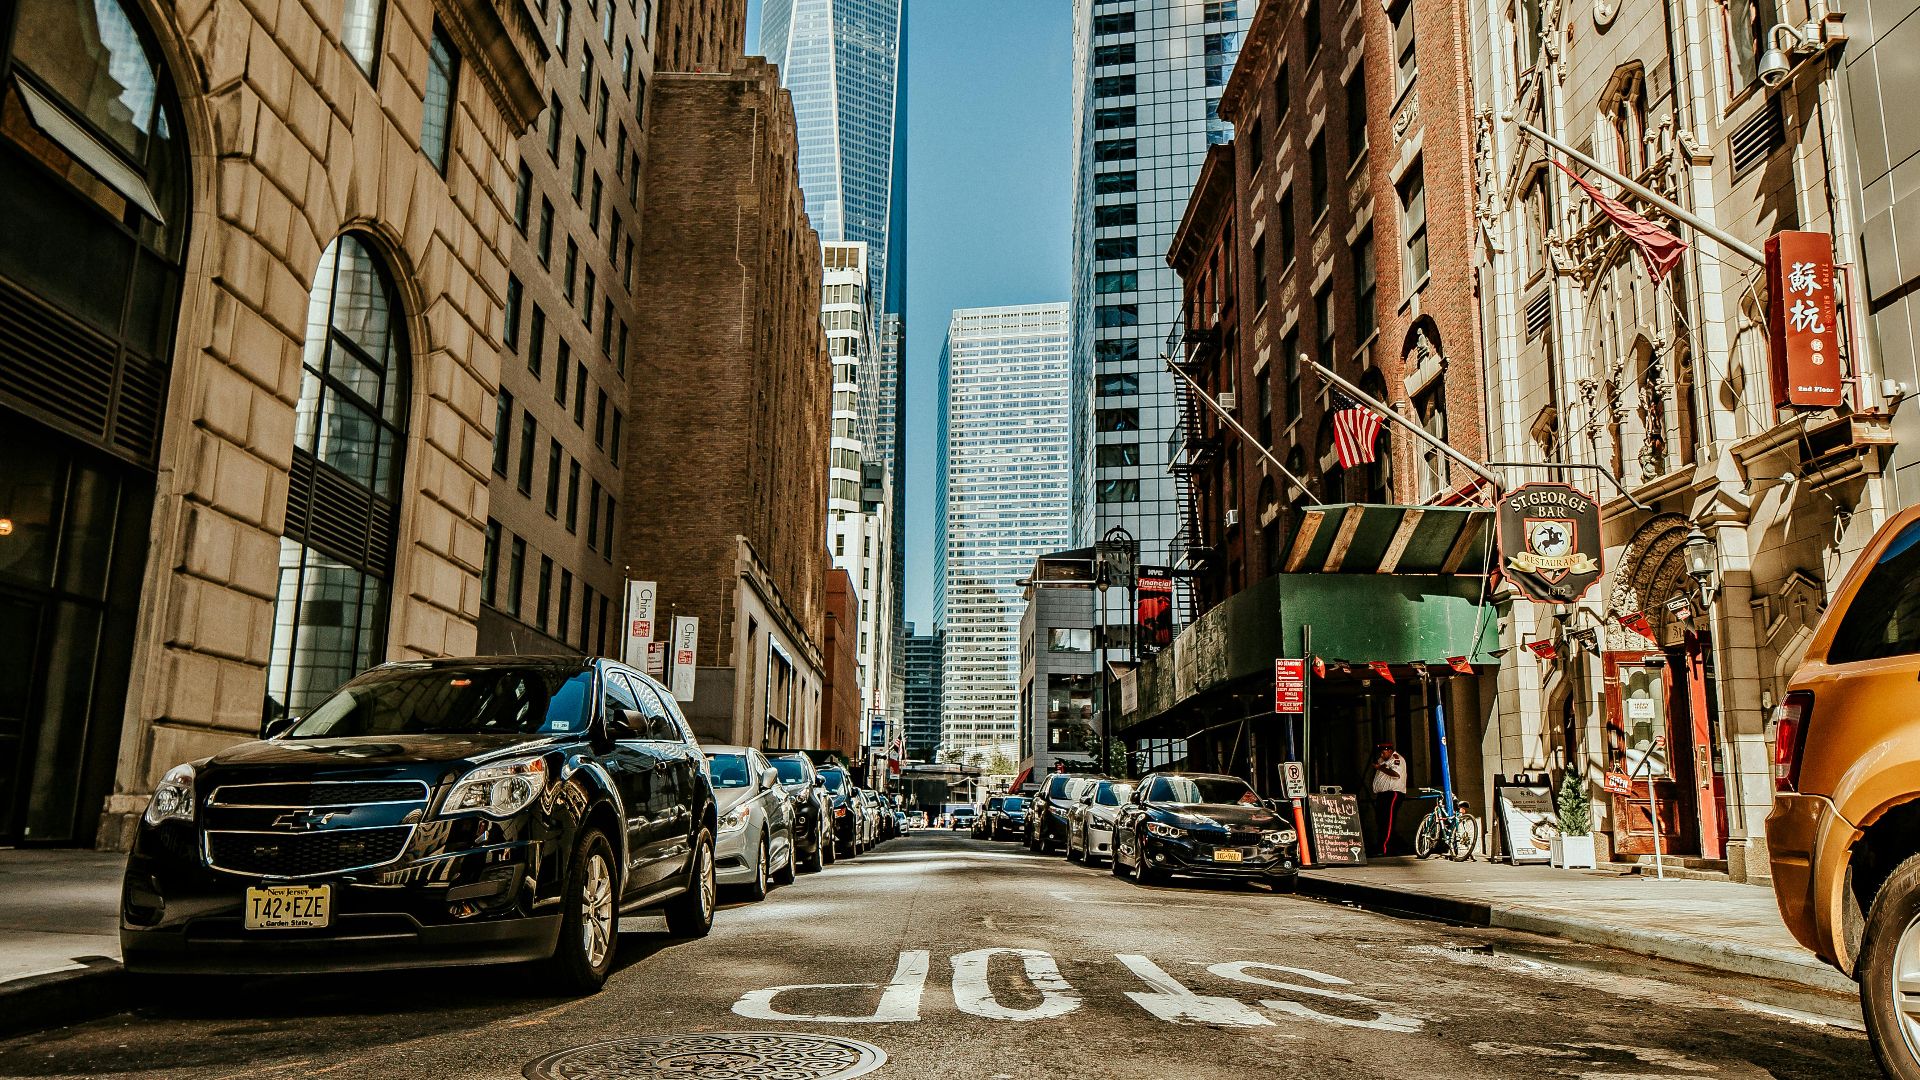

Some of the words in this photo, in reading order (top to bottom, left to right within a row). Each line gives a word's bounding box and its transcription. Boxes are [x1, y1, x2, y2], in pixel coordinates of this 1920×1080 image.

[1788, 261, 1825, 334] 蘇杭
[1823, 295, 1833, 333] SHANGI
[1538, 506, 1567, 518] BAR
[1524, 554, 1581, 567] RESTAURANT
[1138, 578, 1172, 588] financial
[640, 589, 652, 618] China
[684, 623, 694, 648] China
[267, 888, 285, 896] New
[286, 888, 310, 897] Jersey
